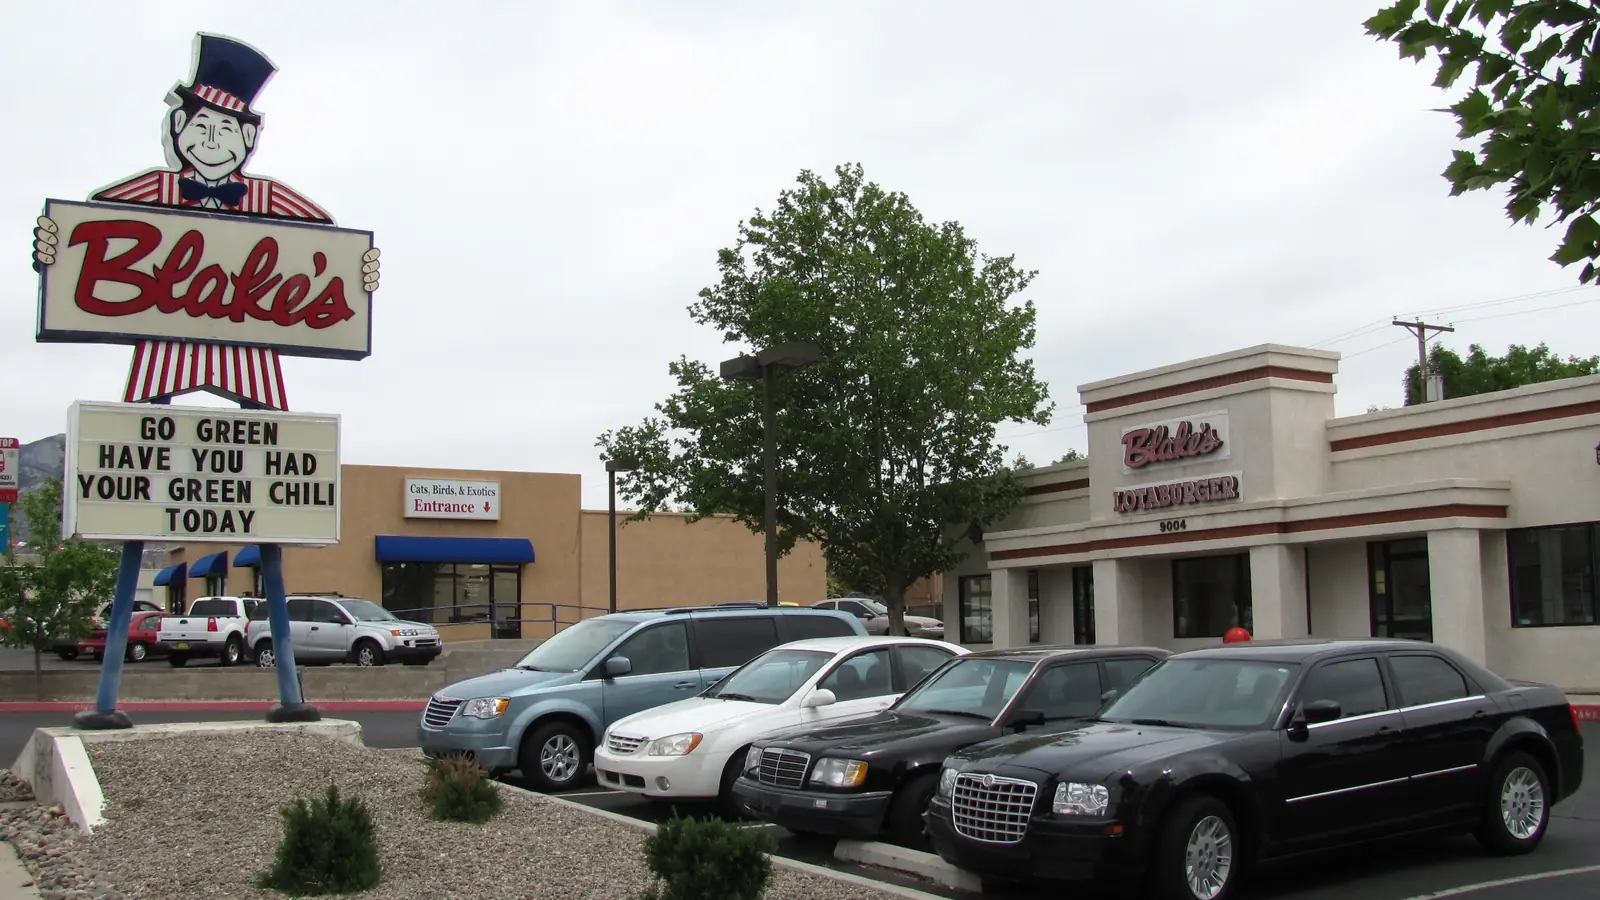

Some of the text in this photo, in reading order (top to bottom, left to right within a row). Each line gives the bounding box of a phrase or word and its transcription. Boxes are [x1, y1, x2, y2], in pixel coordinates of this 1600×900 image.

[68, 220, 355, 329] Blake's
[141, 416, 278, 446] GO GREEN
[1121, 421, 1224, 469] Blake's
[99, 444, 317, 476] HAVE YOU HAD
[78, 475, 335, 506] YOUR GREEN CHILI
[410, 483, 496, 497] Cats, Birds, & Exotics
[1113, 475, 1239, 513] LOTABURGER
[165, 507, 255, 534] TODAY
[414, 498, 475, 513] Entrance
[1160, 519, 1186, 532] 9004
